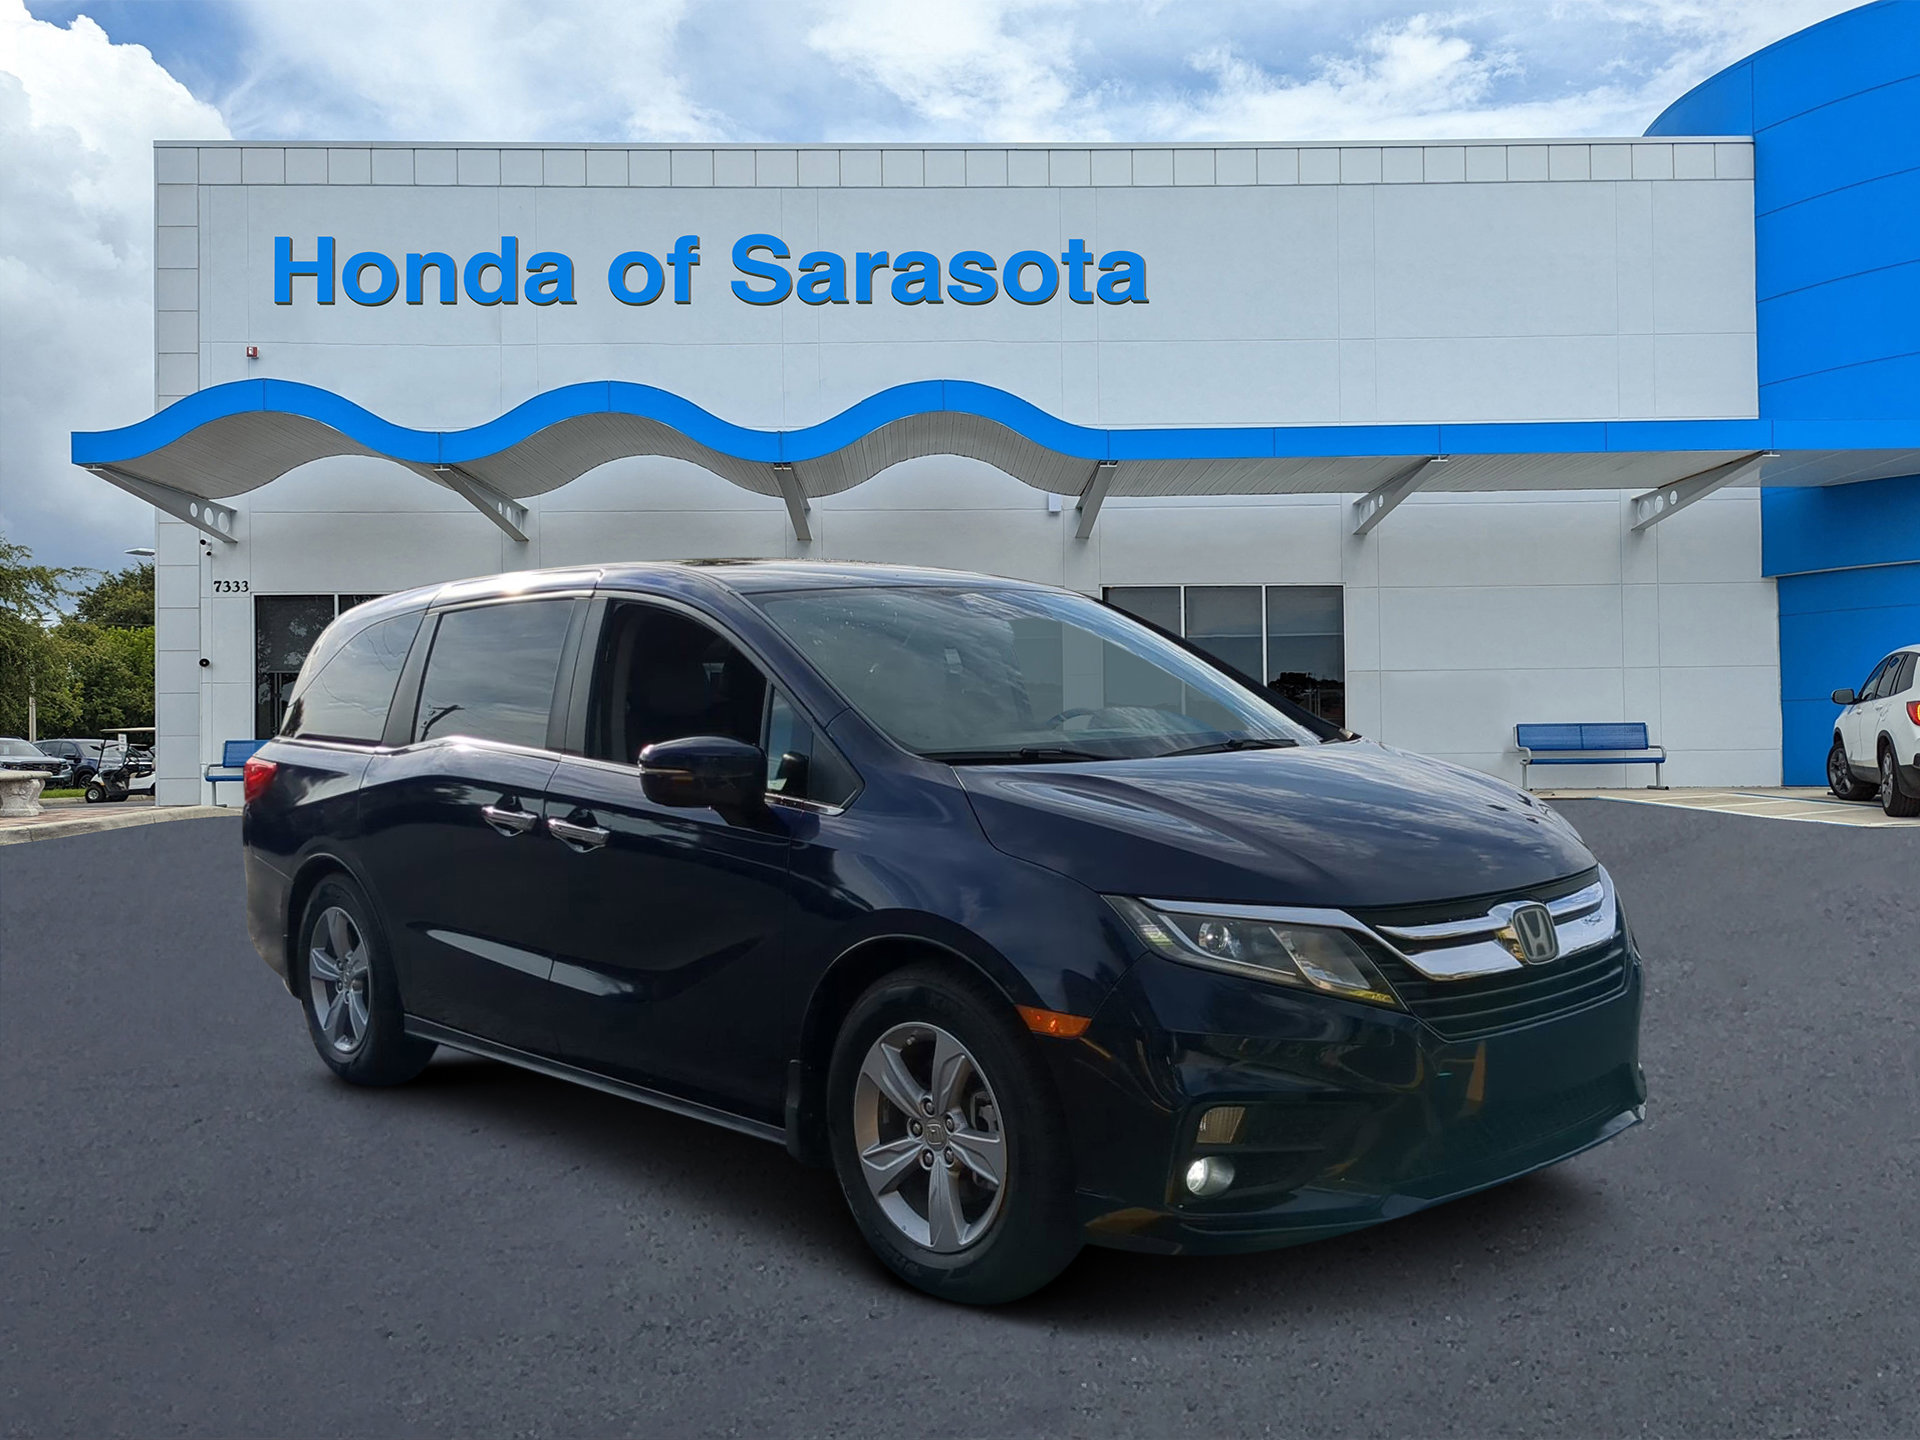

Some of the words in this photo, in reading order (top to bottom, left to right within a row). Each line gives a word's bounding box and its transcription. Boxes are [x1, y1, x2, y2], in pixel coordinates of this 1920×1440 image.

[274, 236, 577, 306] Honda
[608, 235, 701, 306] of
[731, 233, 1150, 306] Sarasota
[213, 580, 249, 593] 7333
